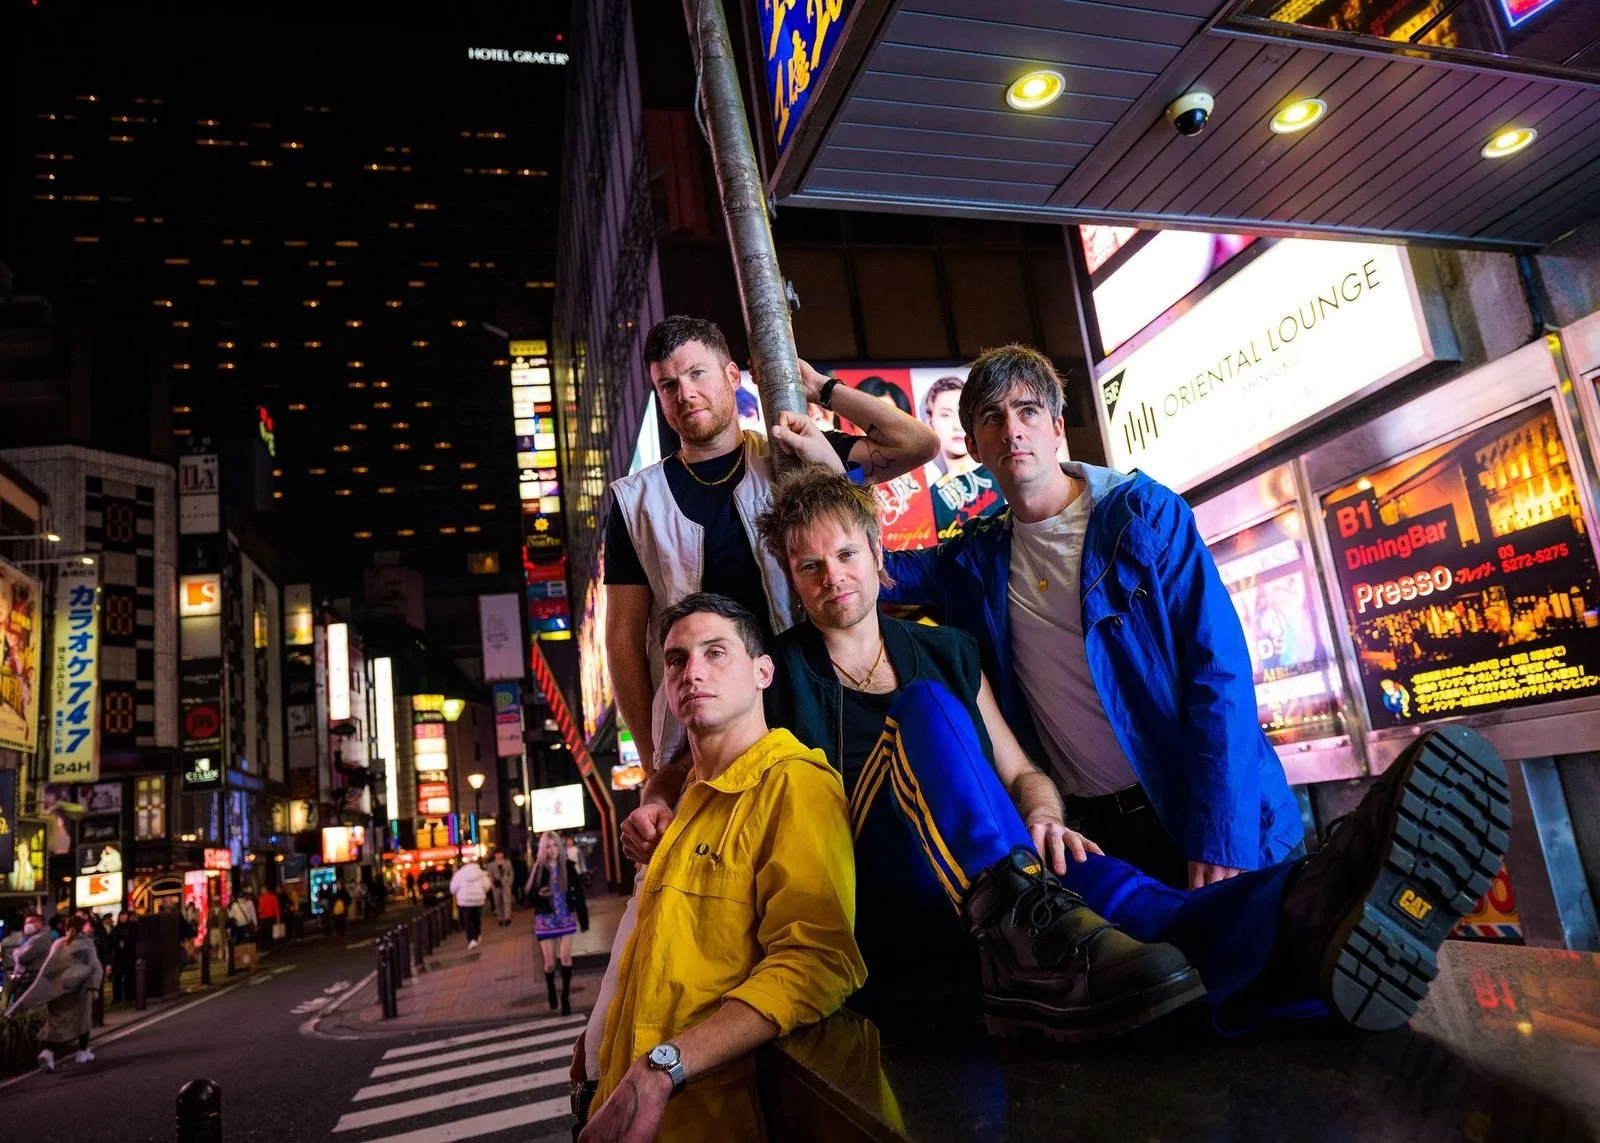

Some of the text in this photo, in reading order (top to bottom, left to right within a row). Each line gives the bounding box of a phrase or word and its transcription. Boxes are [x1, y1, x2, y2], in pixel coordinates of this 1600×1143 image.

[468, 47, 512, 62] HOTEL
[1163, 259, 1381, 417] ORIENTAL LOUNGE
[1336, 499, 1373, 539] B1
[1345, 520, 1448, 570] DiningBar
[1498, 544, 1515, 560] 03
[1502, 543, 1569, 573] 5272-5275
[1352, 565, 1453, 614] Presso
[53, 761, 90, 775] 24H
[1399, 889, 1433, 920] CAT
